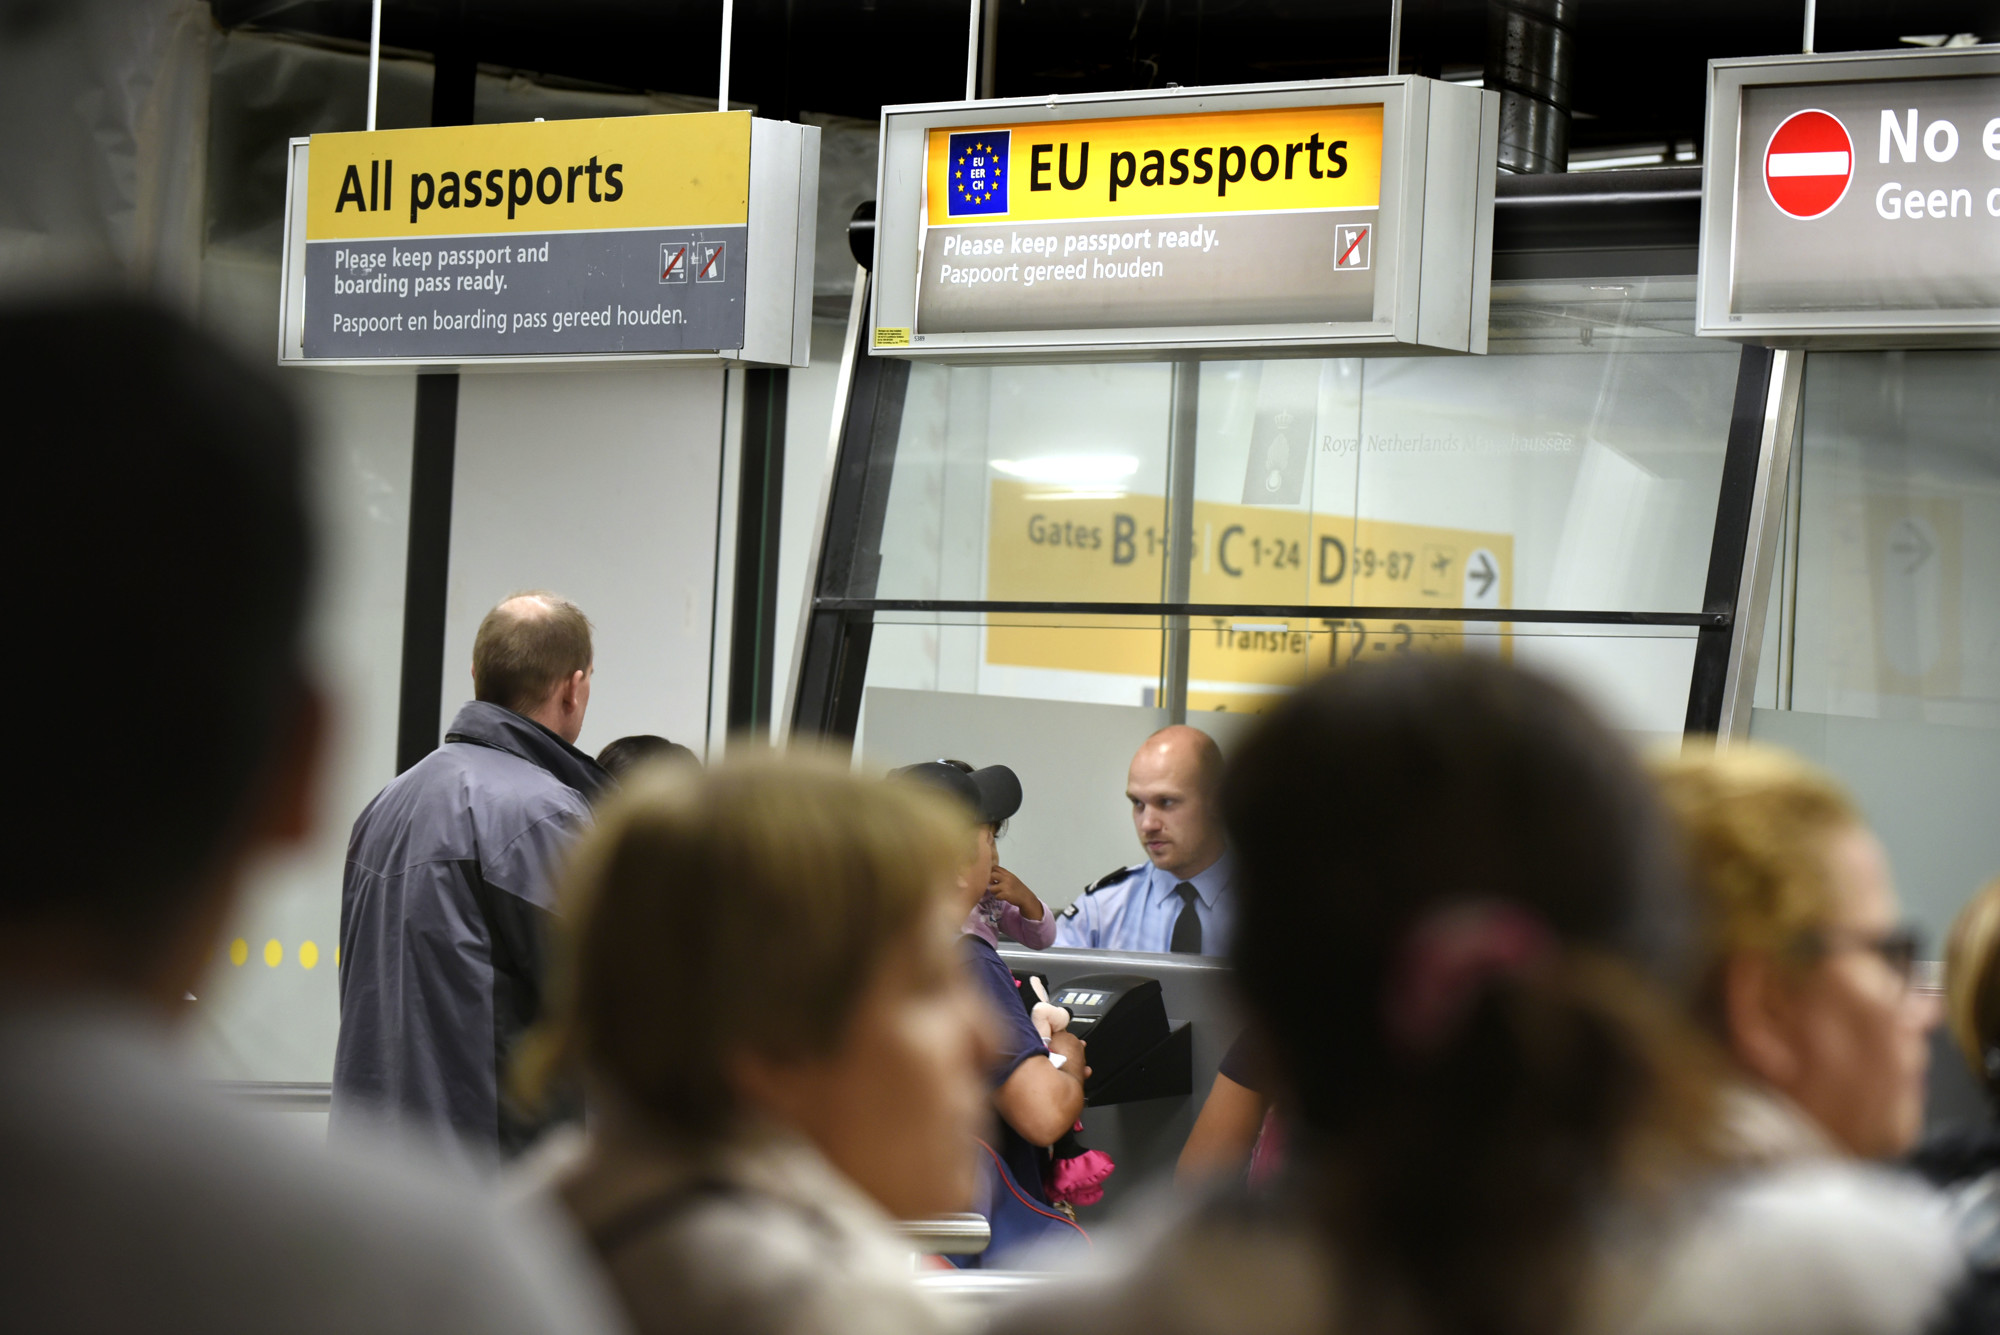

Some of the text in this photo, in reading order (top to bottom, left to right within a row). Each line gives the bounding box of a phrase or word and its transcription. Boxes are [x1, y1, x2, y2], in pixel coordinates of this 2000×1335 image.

[1878, 108, 1960, 164] No
[970, 168, 986, 179] EER
[973, 156, 985, 167] EU
[1030, 132, 1348, 202] EU passports
[335, 155, 624, 224] All passports
[972, 180, 984, 190] CH
[1875, 182, 1972, 219] Geen
[335, 241, 549, 271] Please keep passport and
[943, 223, 1219, 258] Please keep passport ready.
[334, 269, 508, 297] boarding pass ready.
[940, 256, 1163, 288] Paspoort gereed houden
[333, 303, 687, 337] Paspoort en boarding pass gereed houden.
[1367, 434, 1458, 453] Netherlands
[1028, 514, 1102, 550] Gates
[1112, 513, 1137, 566] B
[1218, 524, 1246, 578] C
[1251, 536, 1301, 570] 1-24
[1318, 533, 1347, 586] D
